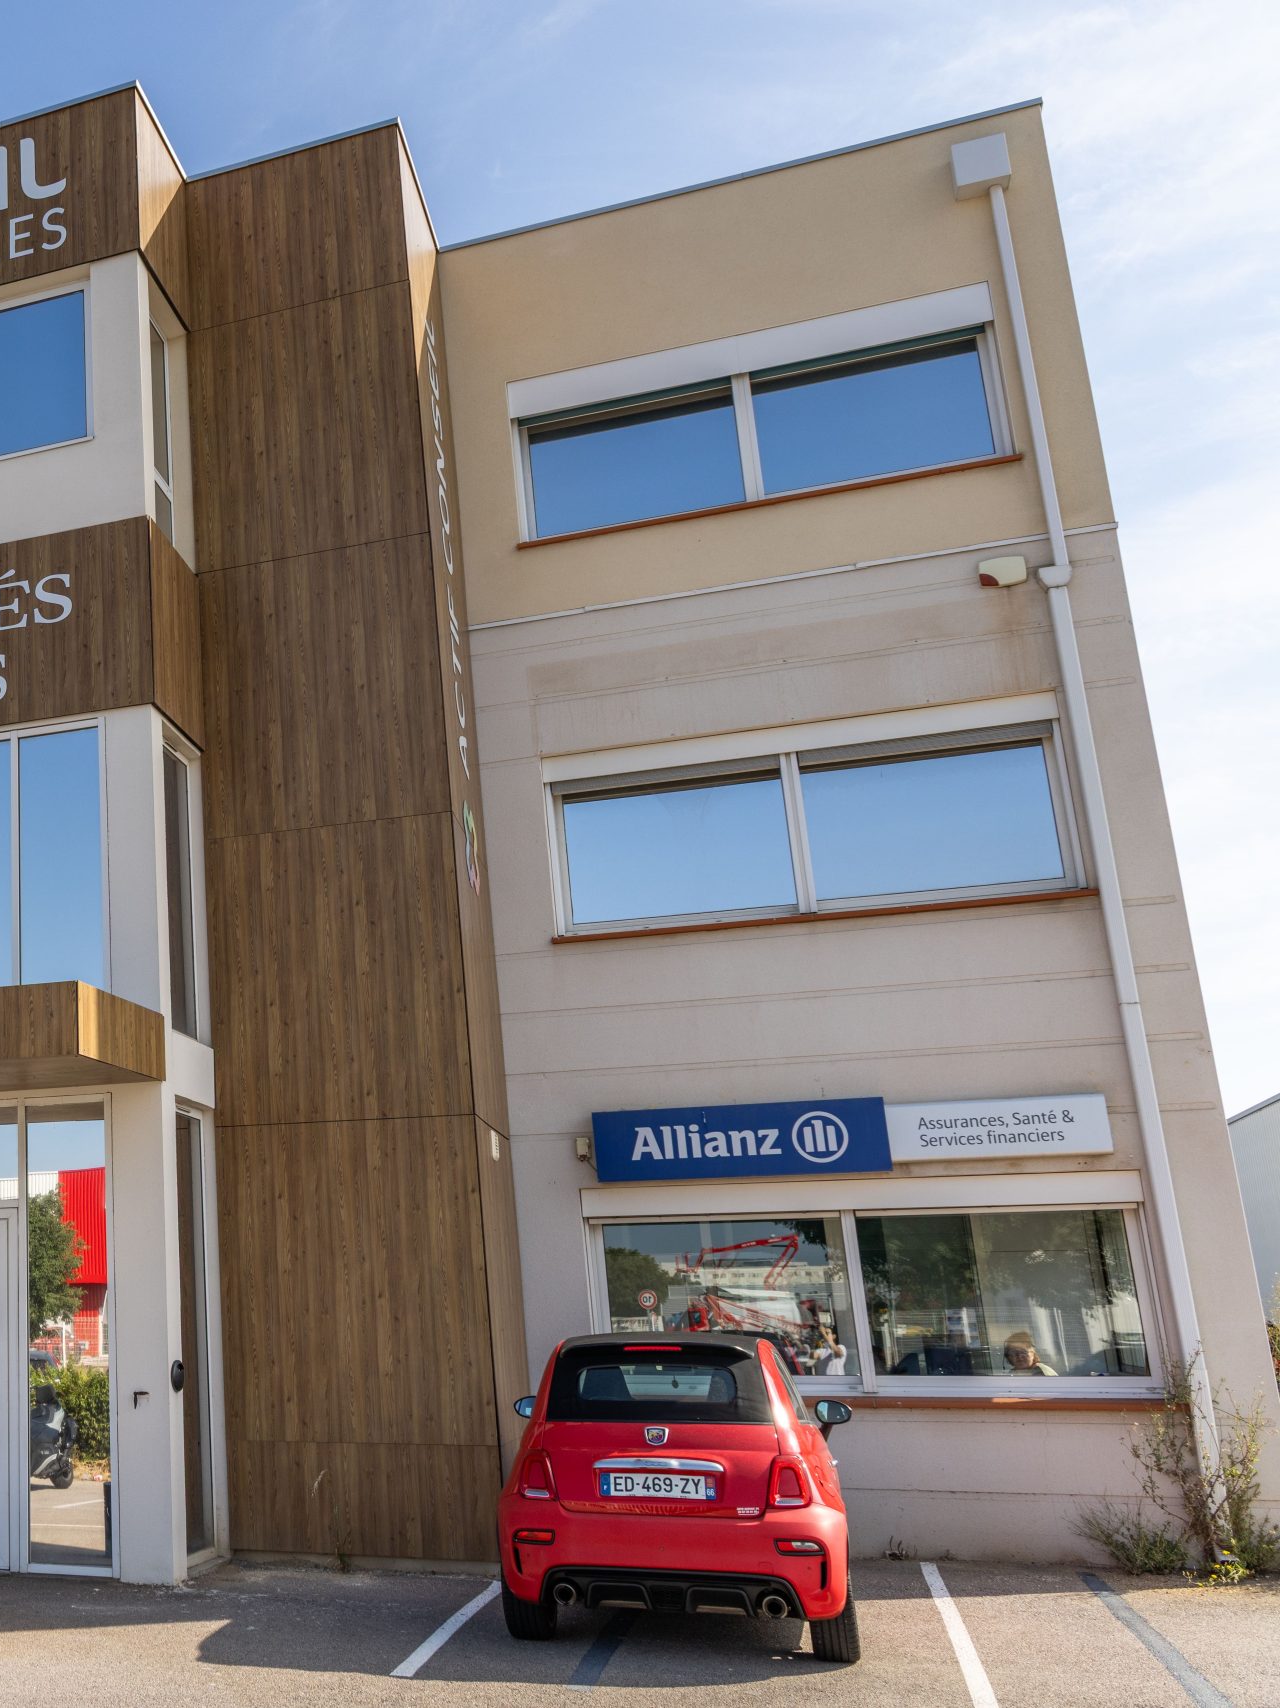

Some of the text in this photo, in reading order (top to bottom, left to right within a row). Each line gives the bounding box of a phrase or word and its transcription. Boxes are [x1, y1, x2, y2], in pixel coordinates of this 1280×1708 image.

[918, 1109, 1074, 1130] Assurances, Santé &
[631, 1123, 782, 1161] Allianz
[920, 1128, 1065, 1148] Services financiers
[613, 1476, 702, 1495] ED-469-ZY
